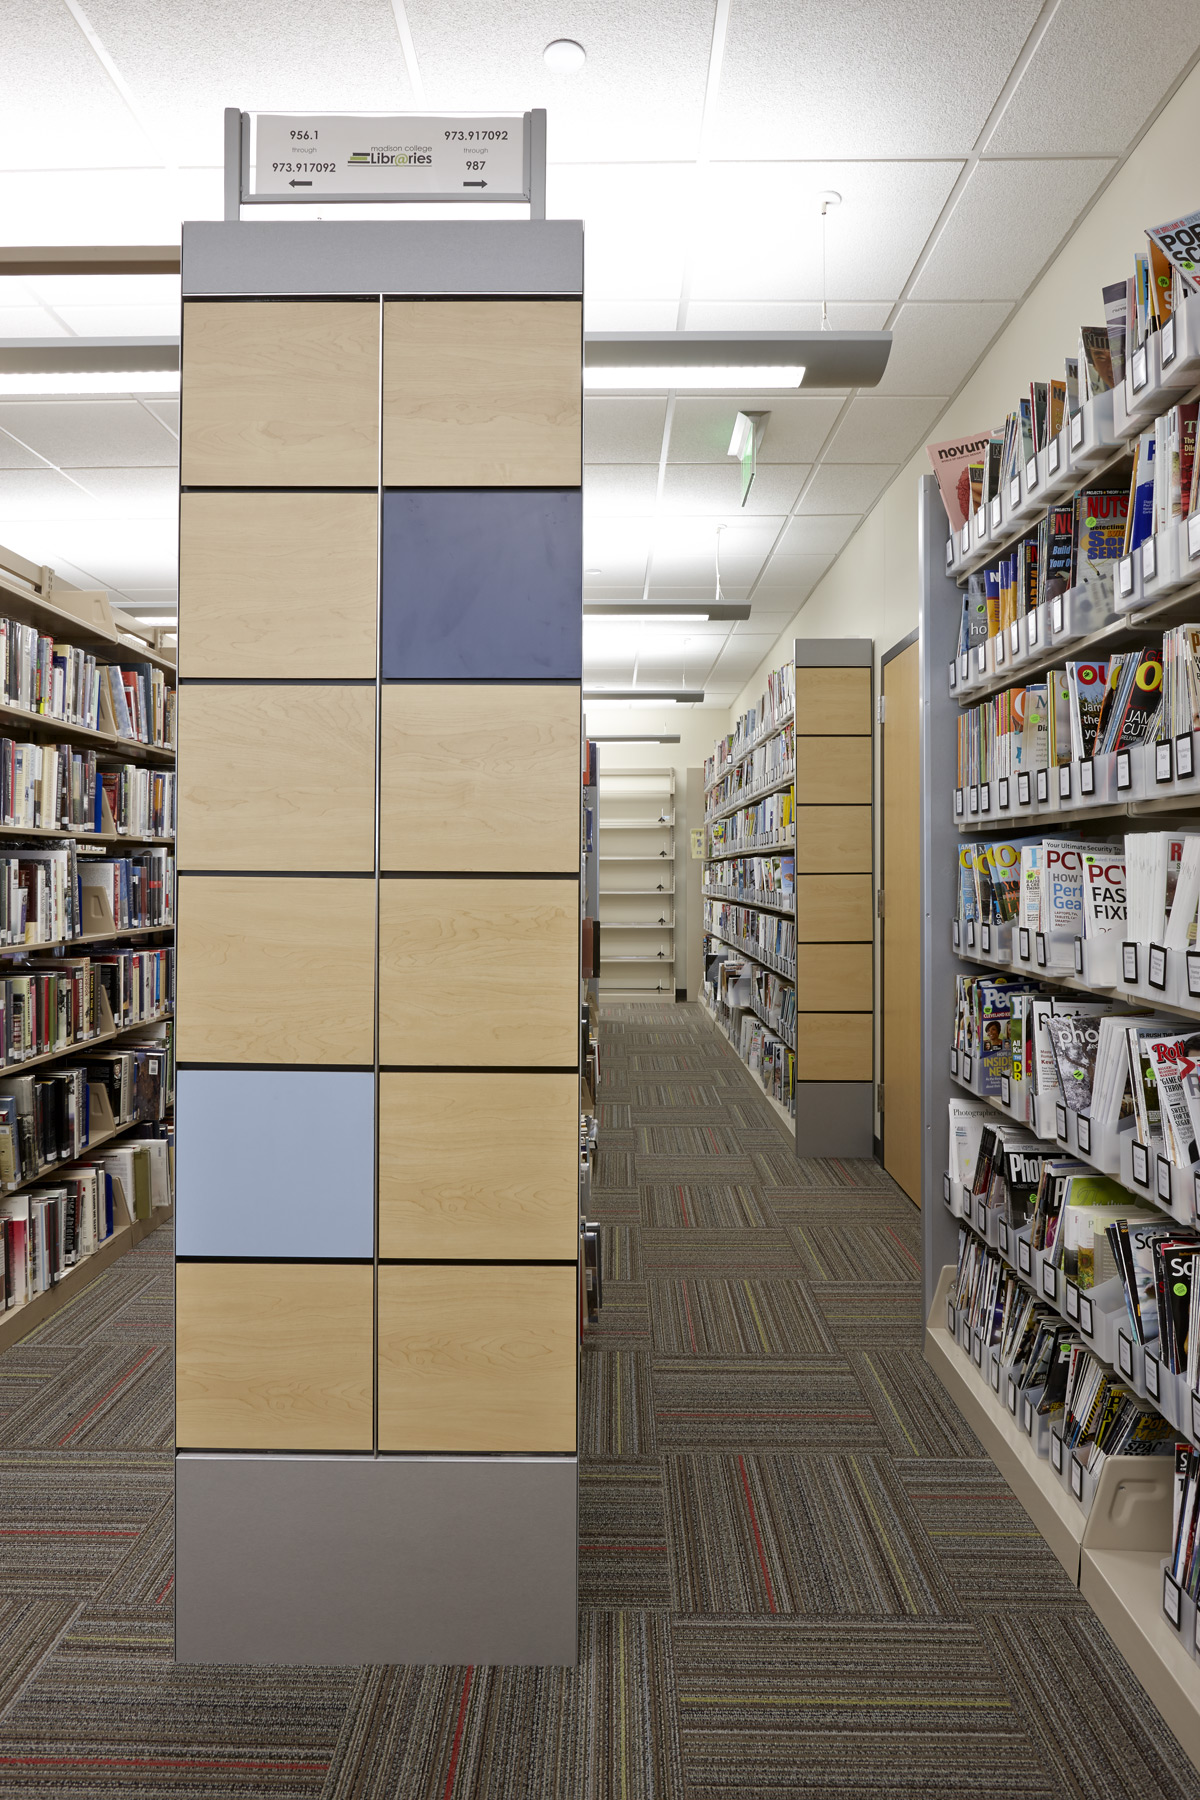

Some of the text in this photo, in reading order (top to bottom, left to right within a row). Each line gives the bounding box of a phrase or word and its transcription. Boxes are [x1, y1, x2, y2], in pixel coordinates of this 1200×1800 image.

[290, 130, 318, 140] 956.1
[445, 131, 508, 141] 973.917092
[371, 153, 432, 166] Libr@ries
[272, 163, 336, 173] 973.917092
[466, 161, 486, 170] 987
[938, 439, 990, 459] novum
[1050, 559, 1065, 568] Your
[1053, 874, 1078, 882] HOW
